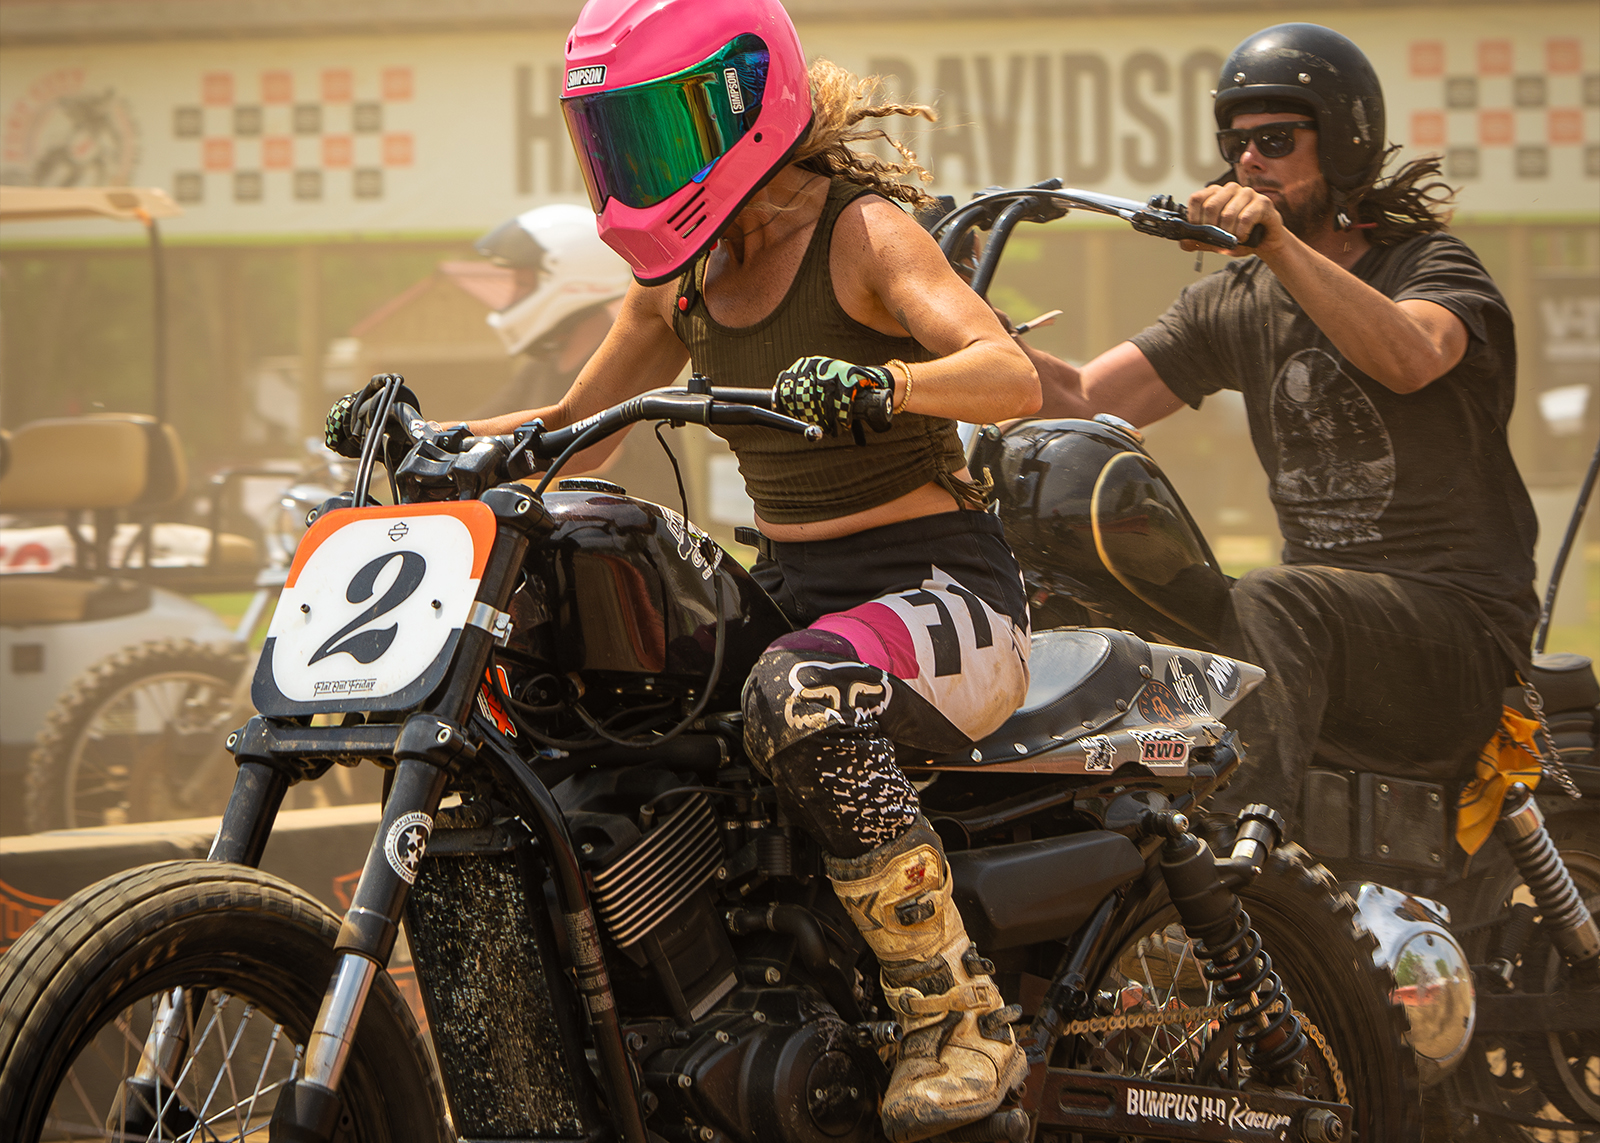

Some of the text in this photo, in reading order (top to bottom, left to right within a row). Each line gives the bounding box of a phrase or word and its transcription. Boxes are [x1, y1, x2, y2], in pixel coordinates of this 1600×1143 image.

[567, 67, 603, 87] SIMPSON
[725, 70, 743, 111] SIMPSON
[866, 49, 1230, 189] DAVIDSO
[307, 550, 427, 667] 2
[1144, 743, 1185, 758] RWD
[1126, 1087, 1199, 1123] BUMPUS
